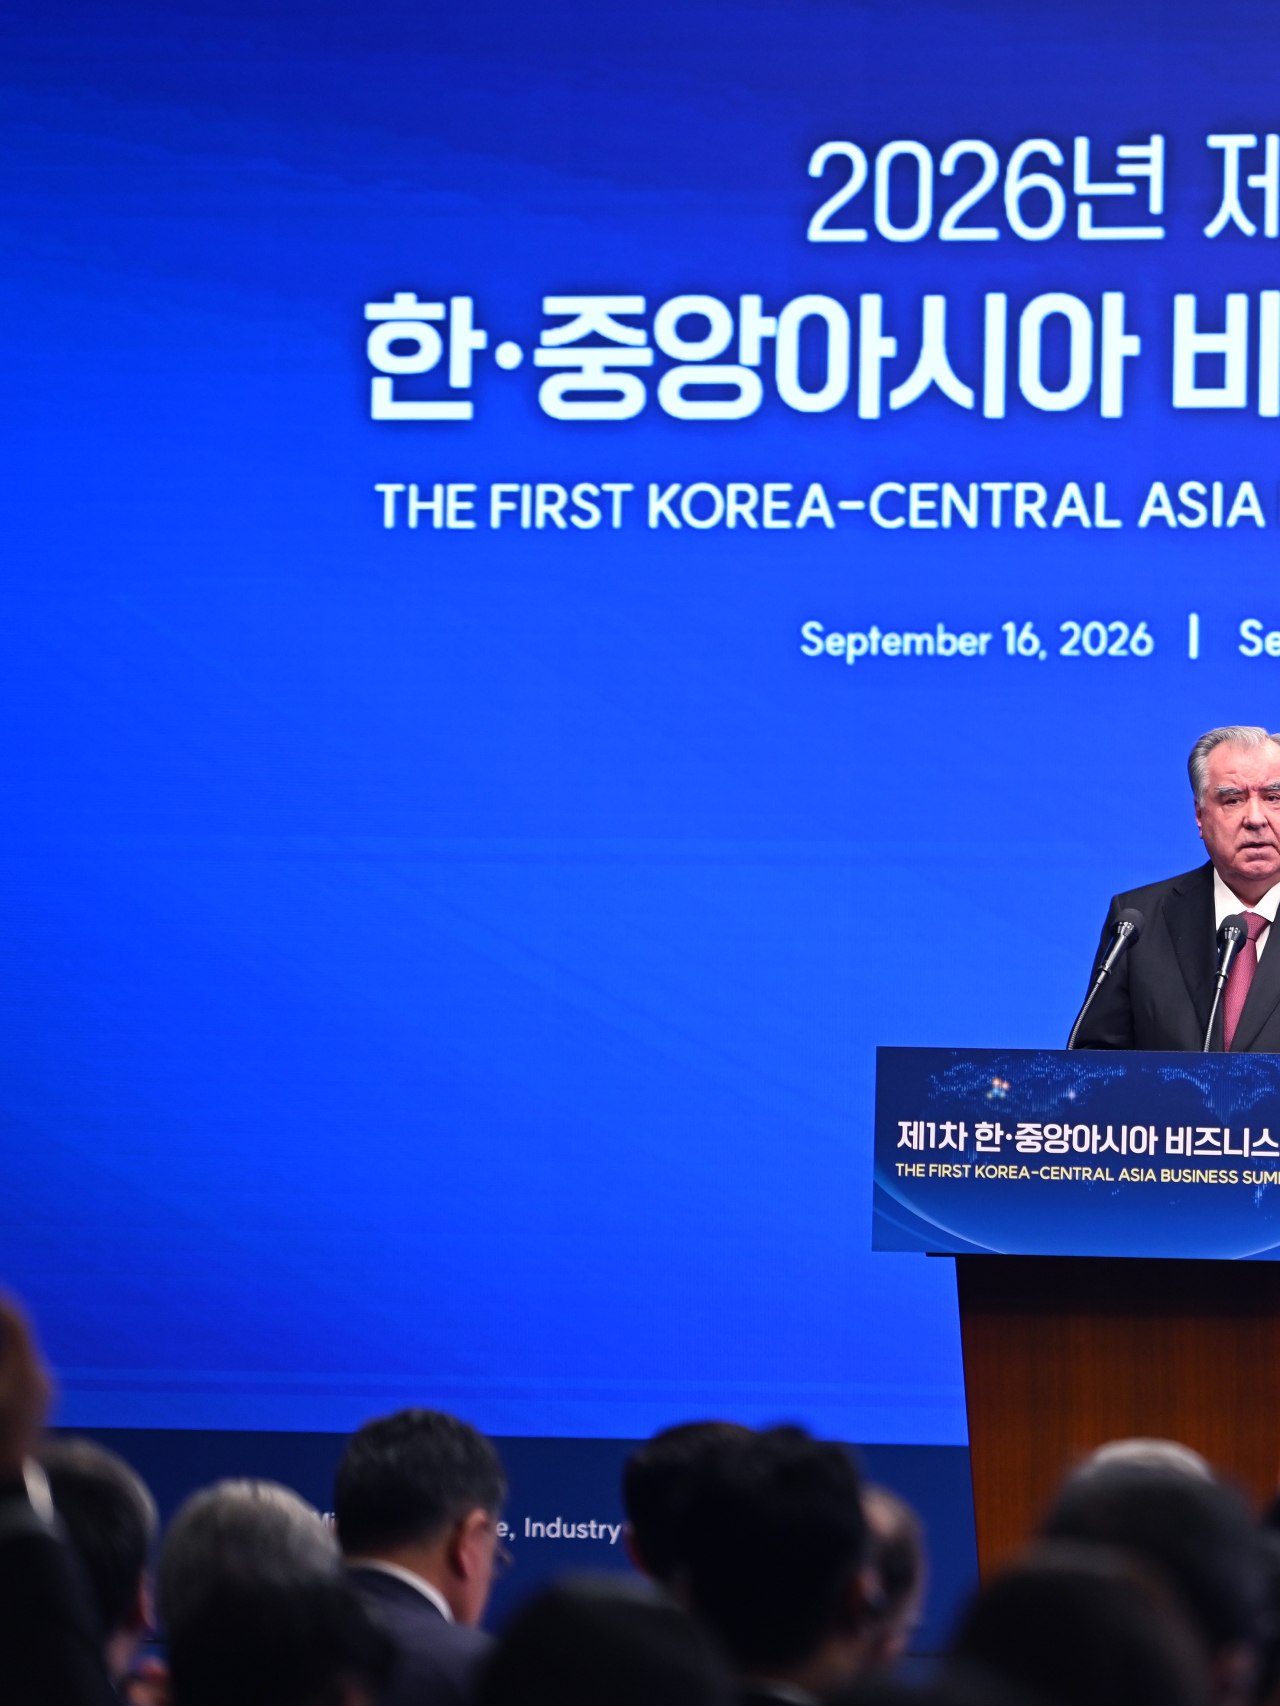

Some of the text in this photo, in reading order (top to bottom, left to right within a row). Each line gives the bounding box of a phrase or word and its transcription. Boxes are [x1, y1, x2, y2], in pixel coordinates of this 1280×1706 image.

[807, 134, 1165, 242] 2026년
[365, 292, 1141, 421] 한·중앙아시아
[375, 483, 477, 529] THE
[490, 483, 634, 529] FIRST
[648, 482, 1122, 529] KOREA-CENTRAL
[1138, 481, 1265, 528] ASIA
[801, 621, 1154, 664] September 16, 2026
[896, 1120, 969, 1152] 제1차
[974, 1121, 1159, 1156] 한·중앙아시아
[1165, 1126, 1280, 1159] 비즈니스
[895, 1163, 926, 1178] THE
[929, 1164, 972, 1179] FIRST
[974, 1165, 1115, 1182] KOREA-CENTRAL
[1118, 1166, 1158, 1183] ASIA
[1160, 1168, 1239, 1185] BUSINESS
[524, 1517, 621, 1545] Industry
